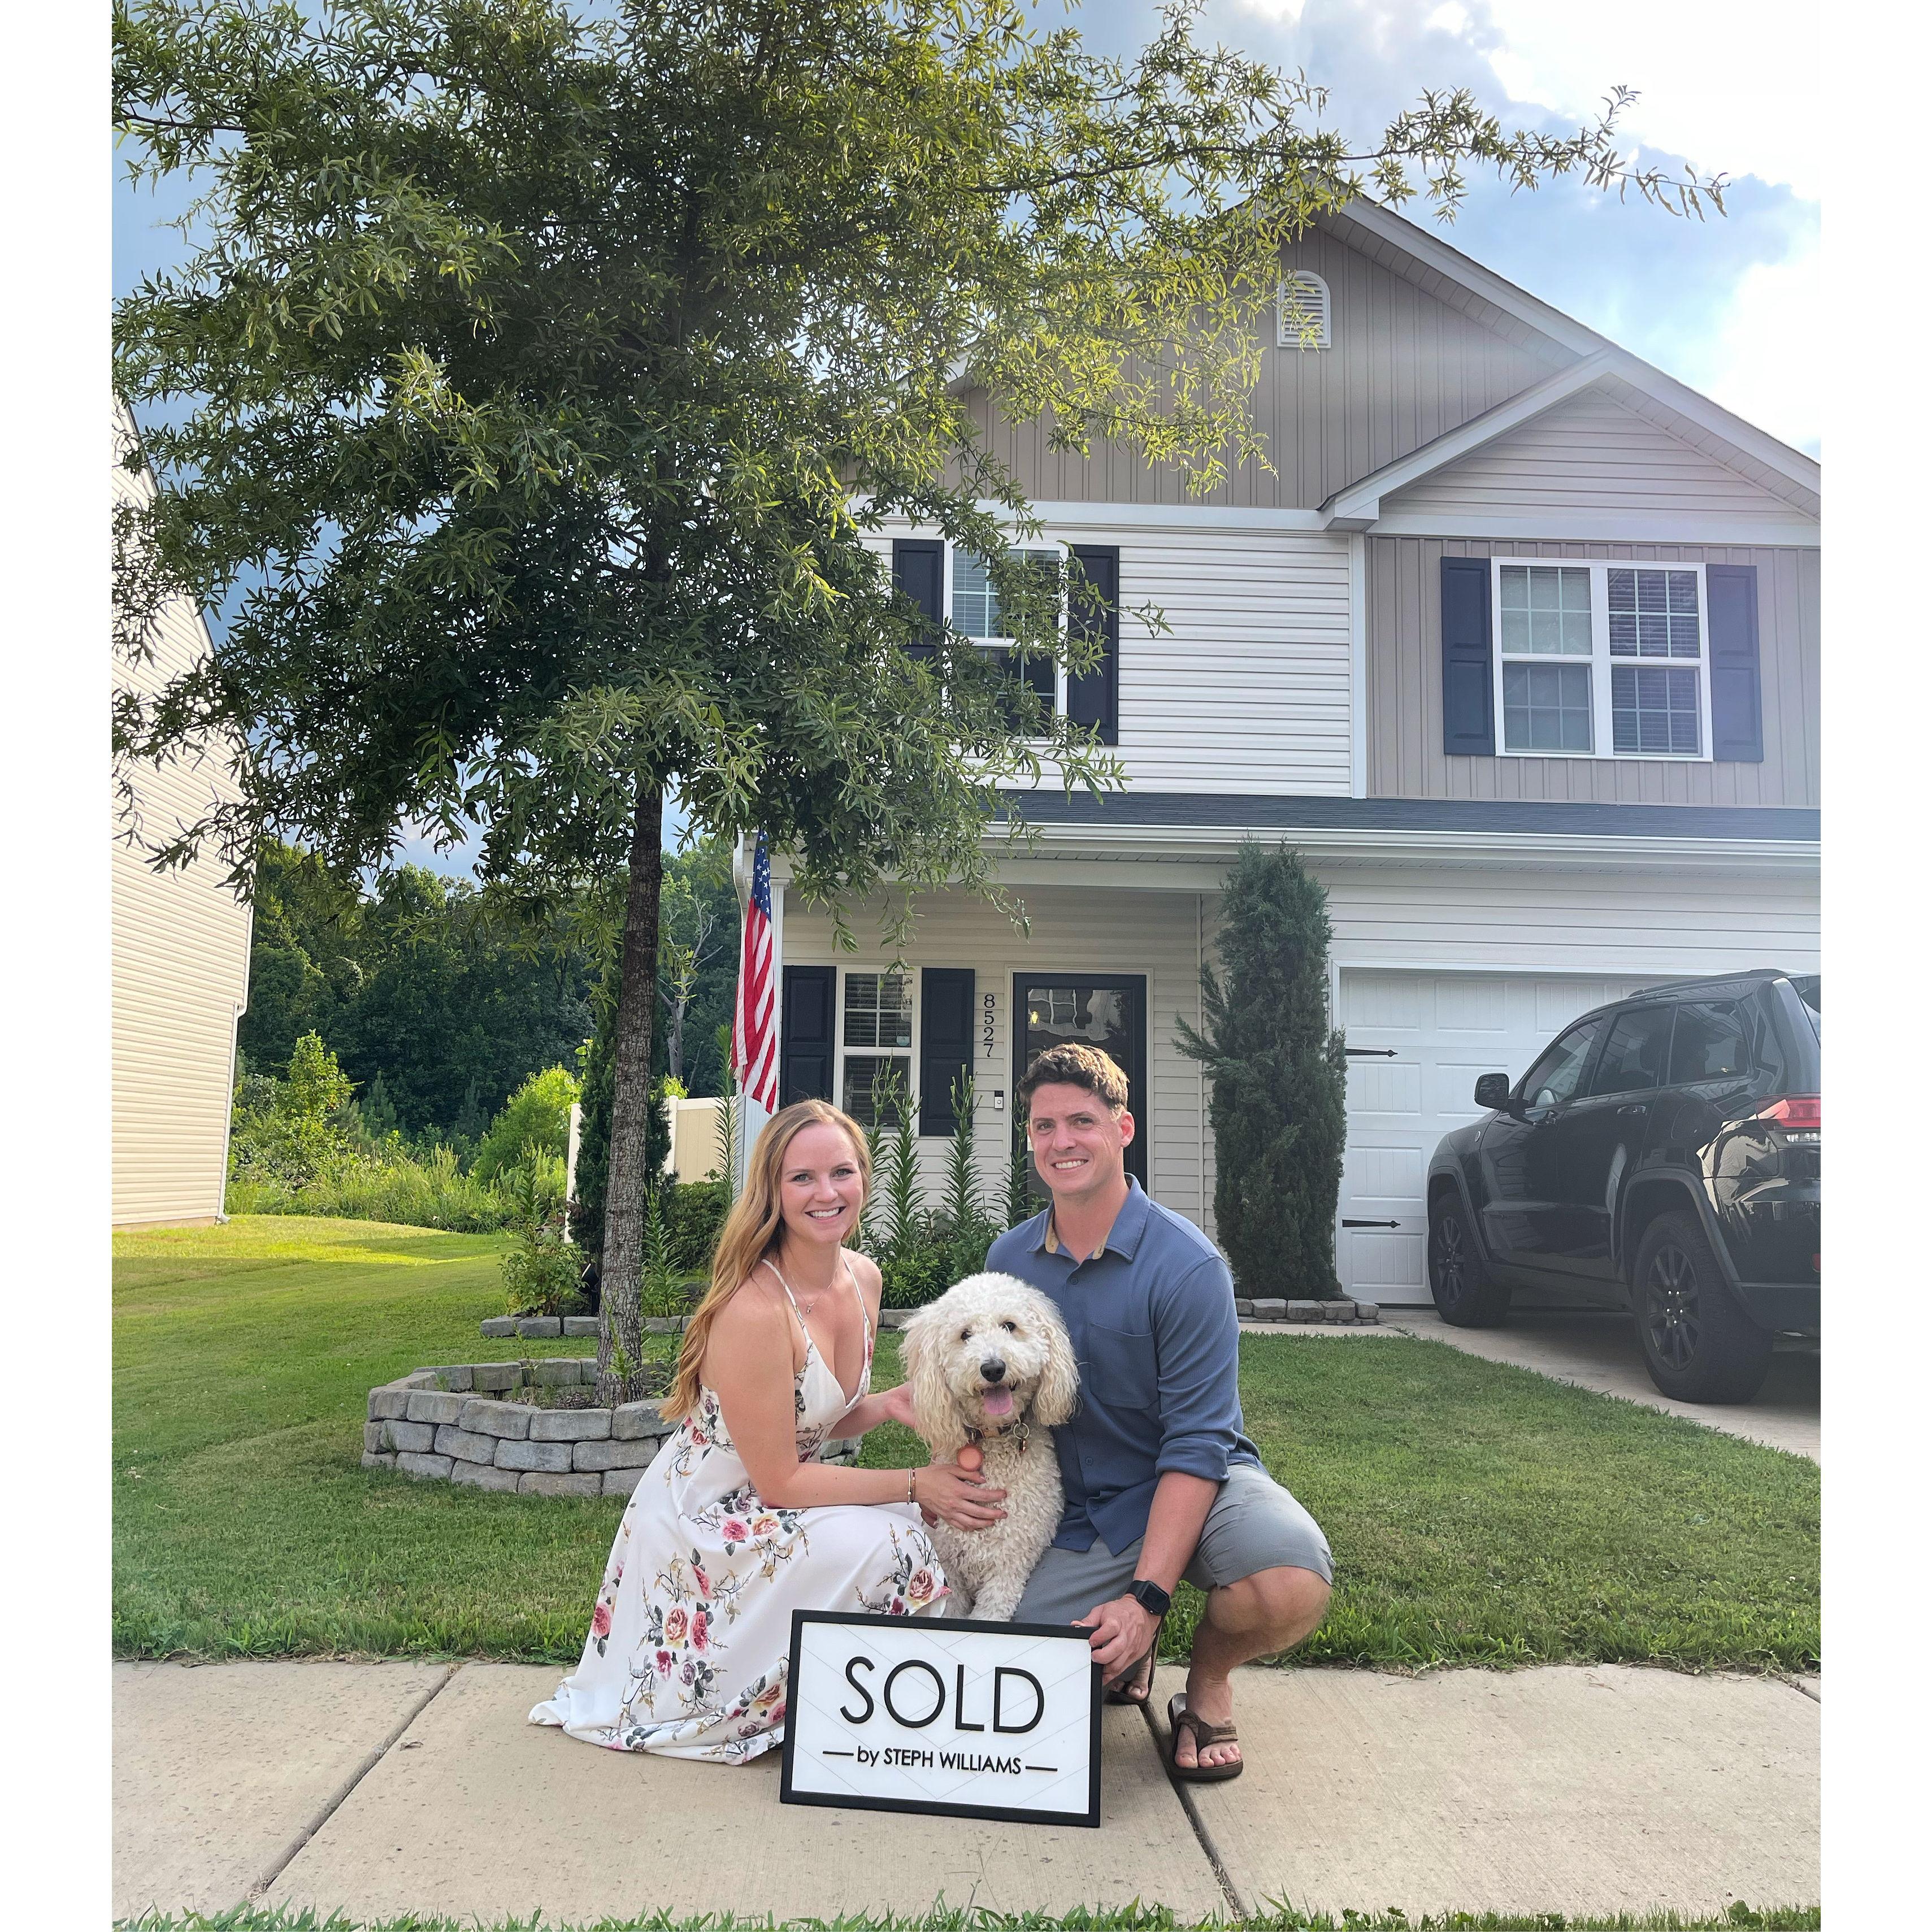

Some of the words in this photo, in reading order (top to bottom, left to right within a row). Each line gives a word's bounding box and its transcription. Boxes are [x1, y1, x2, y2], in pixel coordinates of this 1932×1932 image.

[983, 994, 995, 1057] 8527
[840, 1656, 1044, 1733] SOLD
[857, 1746, 880, 1767] by
[884, 1748, 933, 1768] STEPH
[940, 1752, 1021, 1774] WILLIAMS
